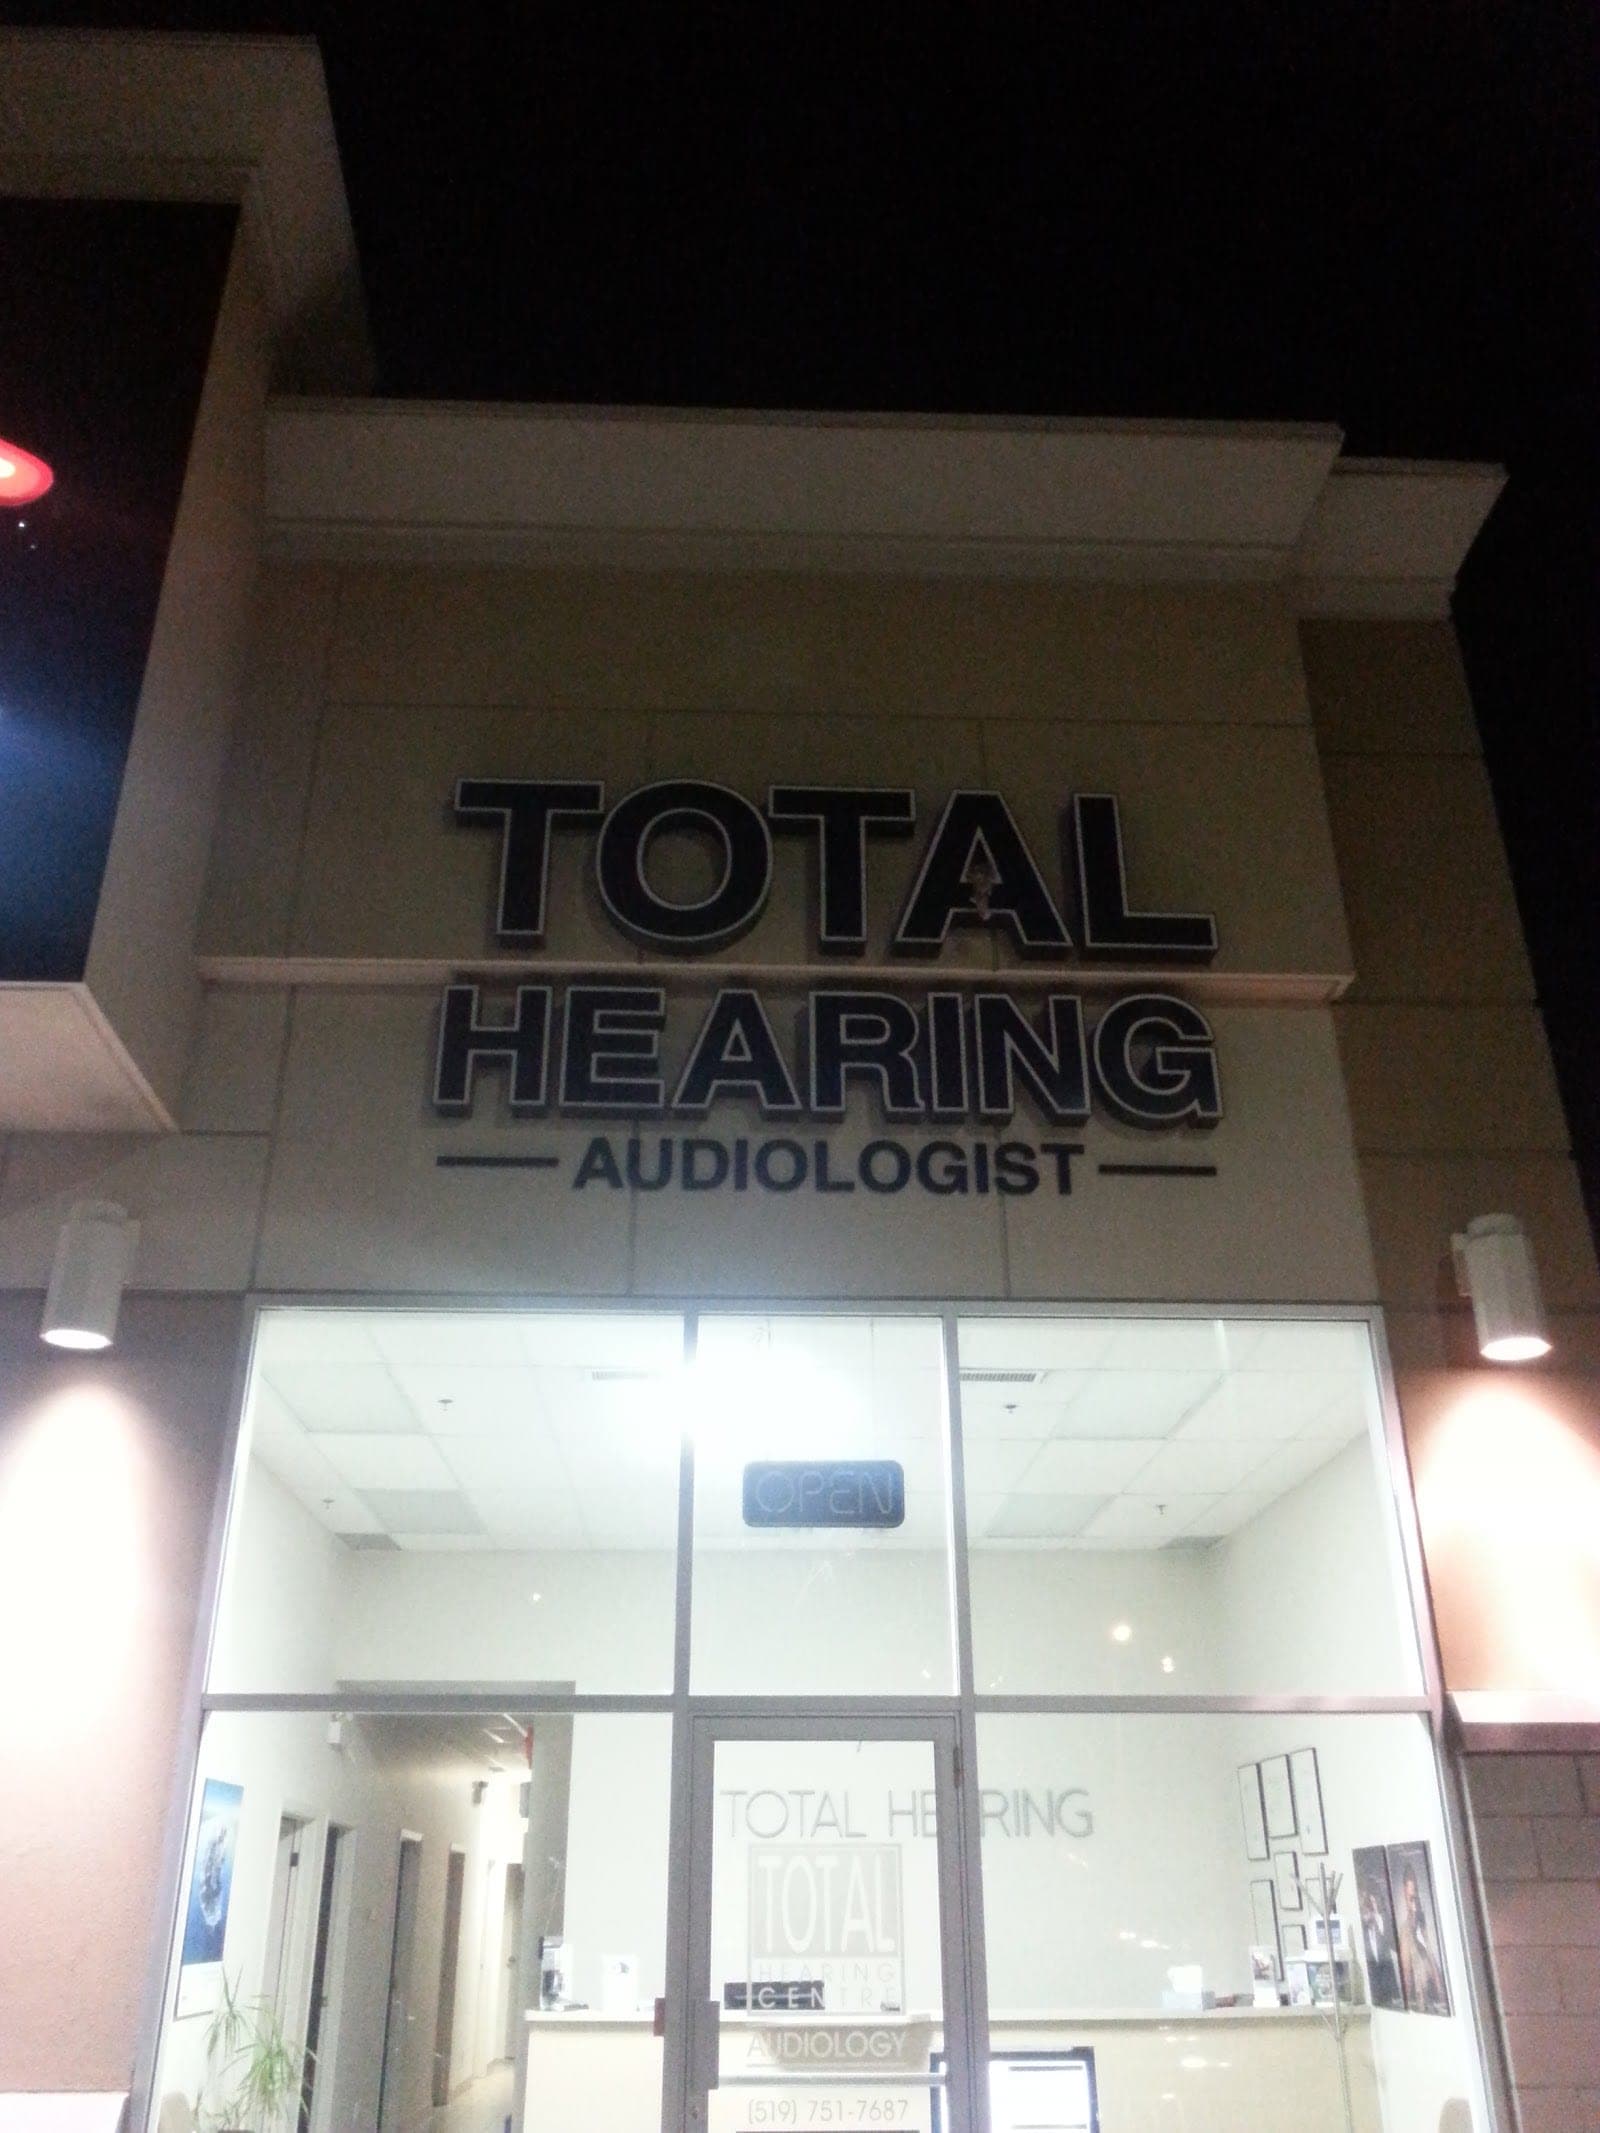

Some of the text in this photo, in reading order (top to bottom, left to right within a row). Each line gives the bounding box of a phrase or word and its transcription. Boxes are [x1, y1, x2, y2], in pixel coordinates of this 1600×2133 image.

[454, 778, 1219, 958] TOTAL
[433, 984, 1223, 1127] HEARING
[572, 1137, 1085, 1196] AUDIOLOGIST
[755, 1470, 893, 1515] OPEN
[720, 1787, 1094, 1839] TOTAL HERING
[757, 1853, 897, 1953] TOTAL
[758, 1961, 896, 1984] HEARING
[758, 1986, 897, 2009] CENTRE
[747, 2030, 907, 2058] AUDIOLOGY
[748, 2099, 909, 2125] (519) 751-7687
